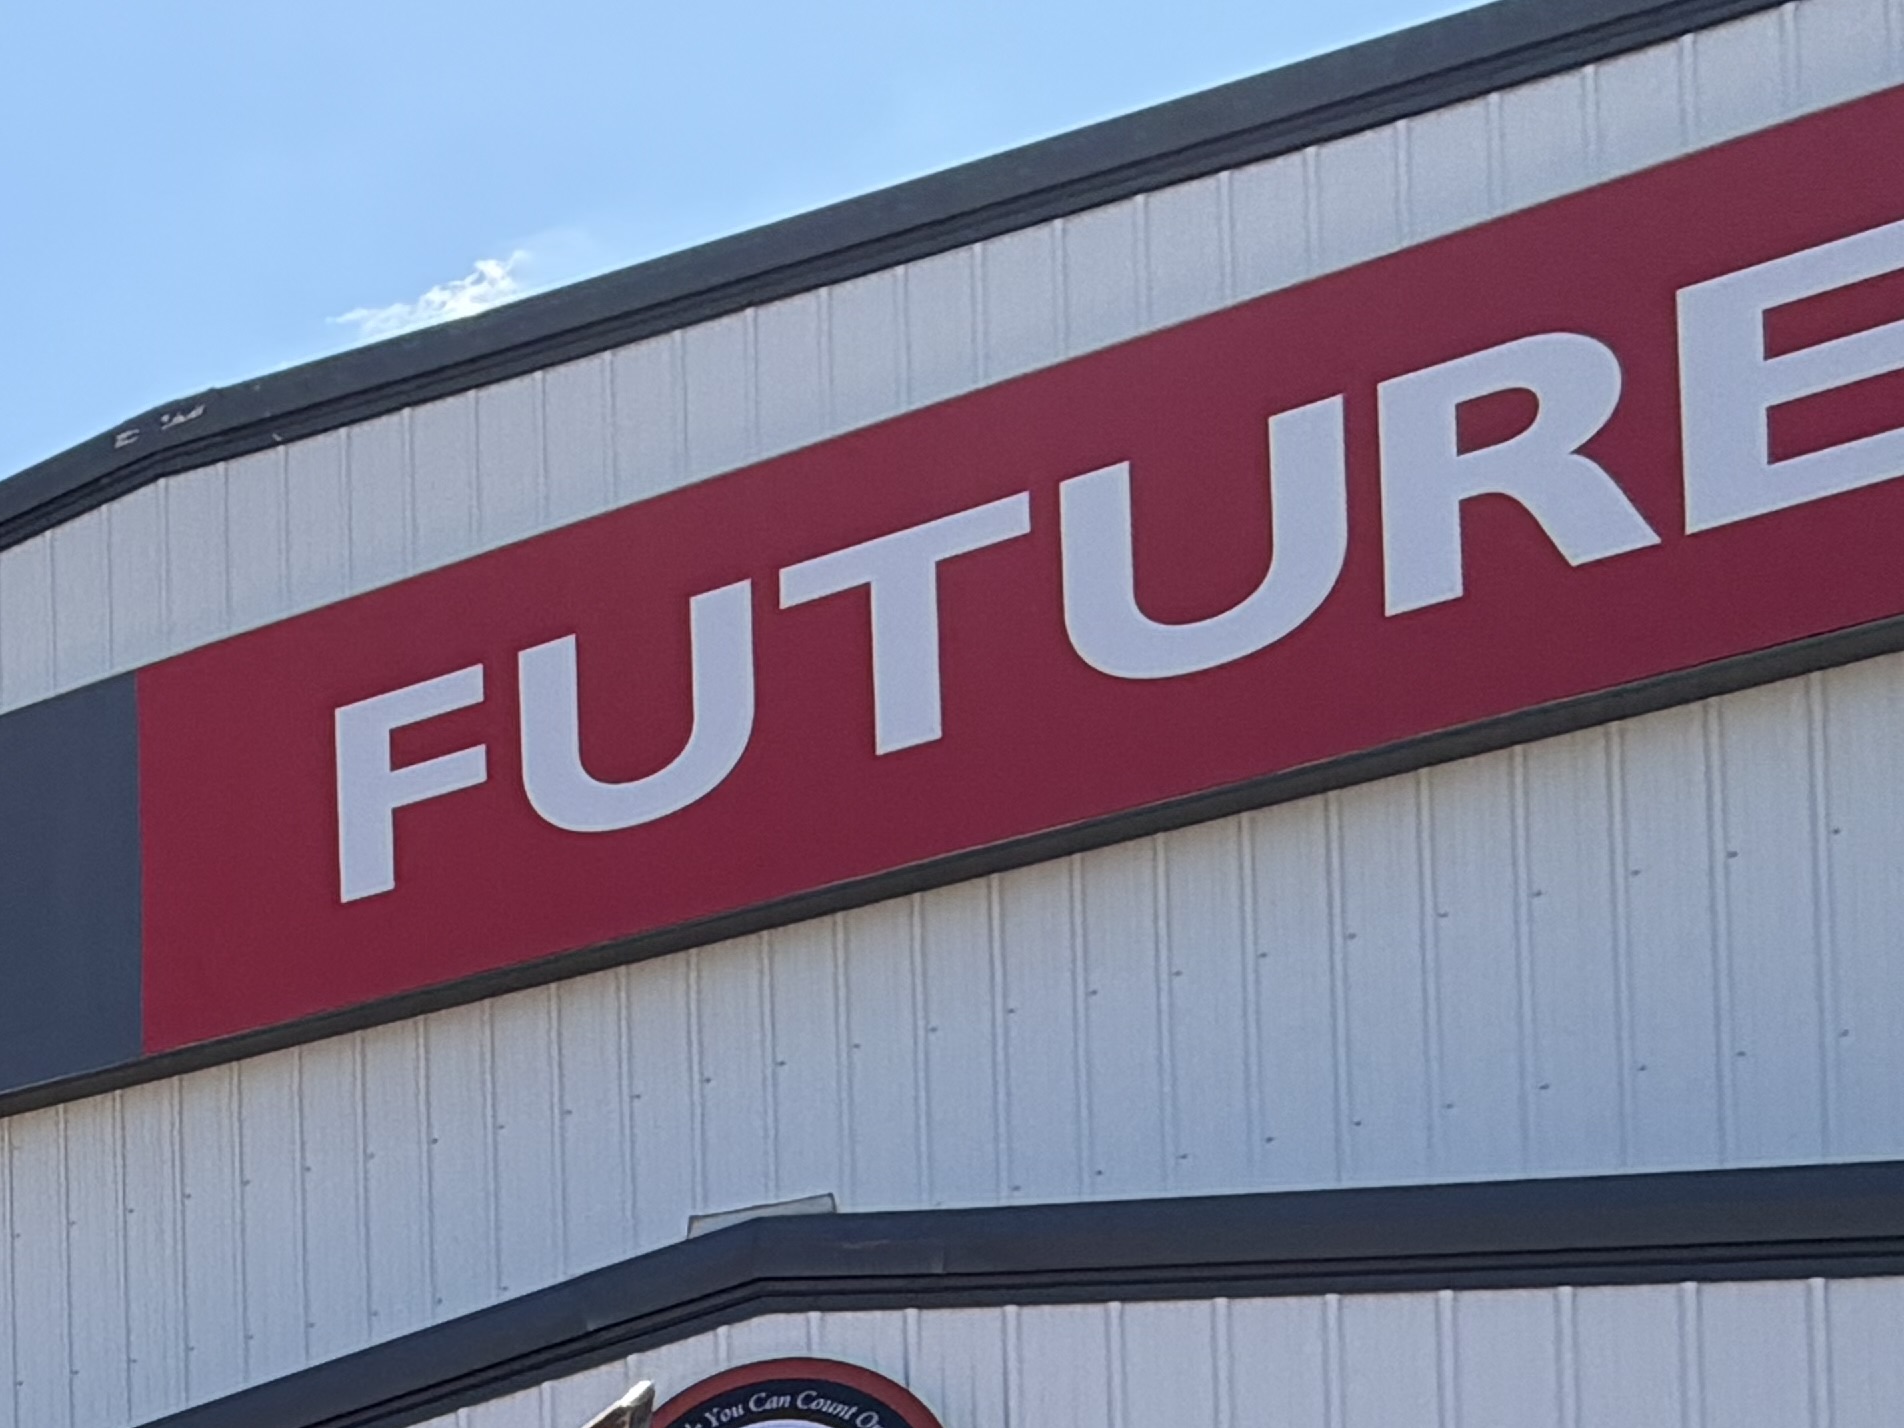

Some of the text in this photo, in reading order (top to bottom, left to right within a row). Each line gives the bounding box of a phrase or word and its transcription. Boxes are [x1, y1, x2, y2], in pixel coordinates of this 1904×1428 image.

[334, 221, 1904, 903] FUTURE
[705, 1403, 744, 1428] You
[749, 1392, 791, 1414] Can
[796, 1390, 858, 1420] Count
